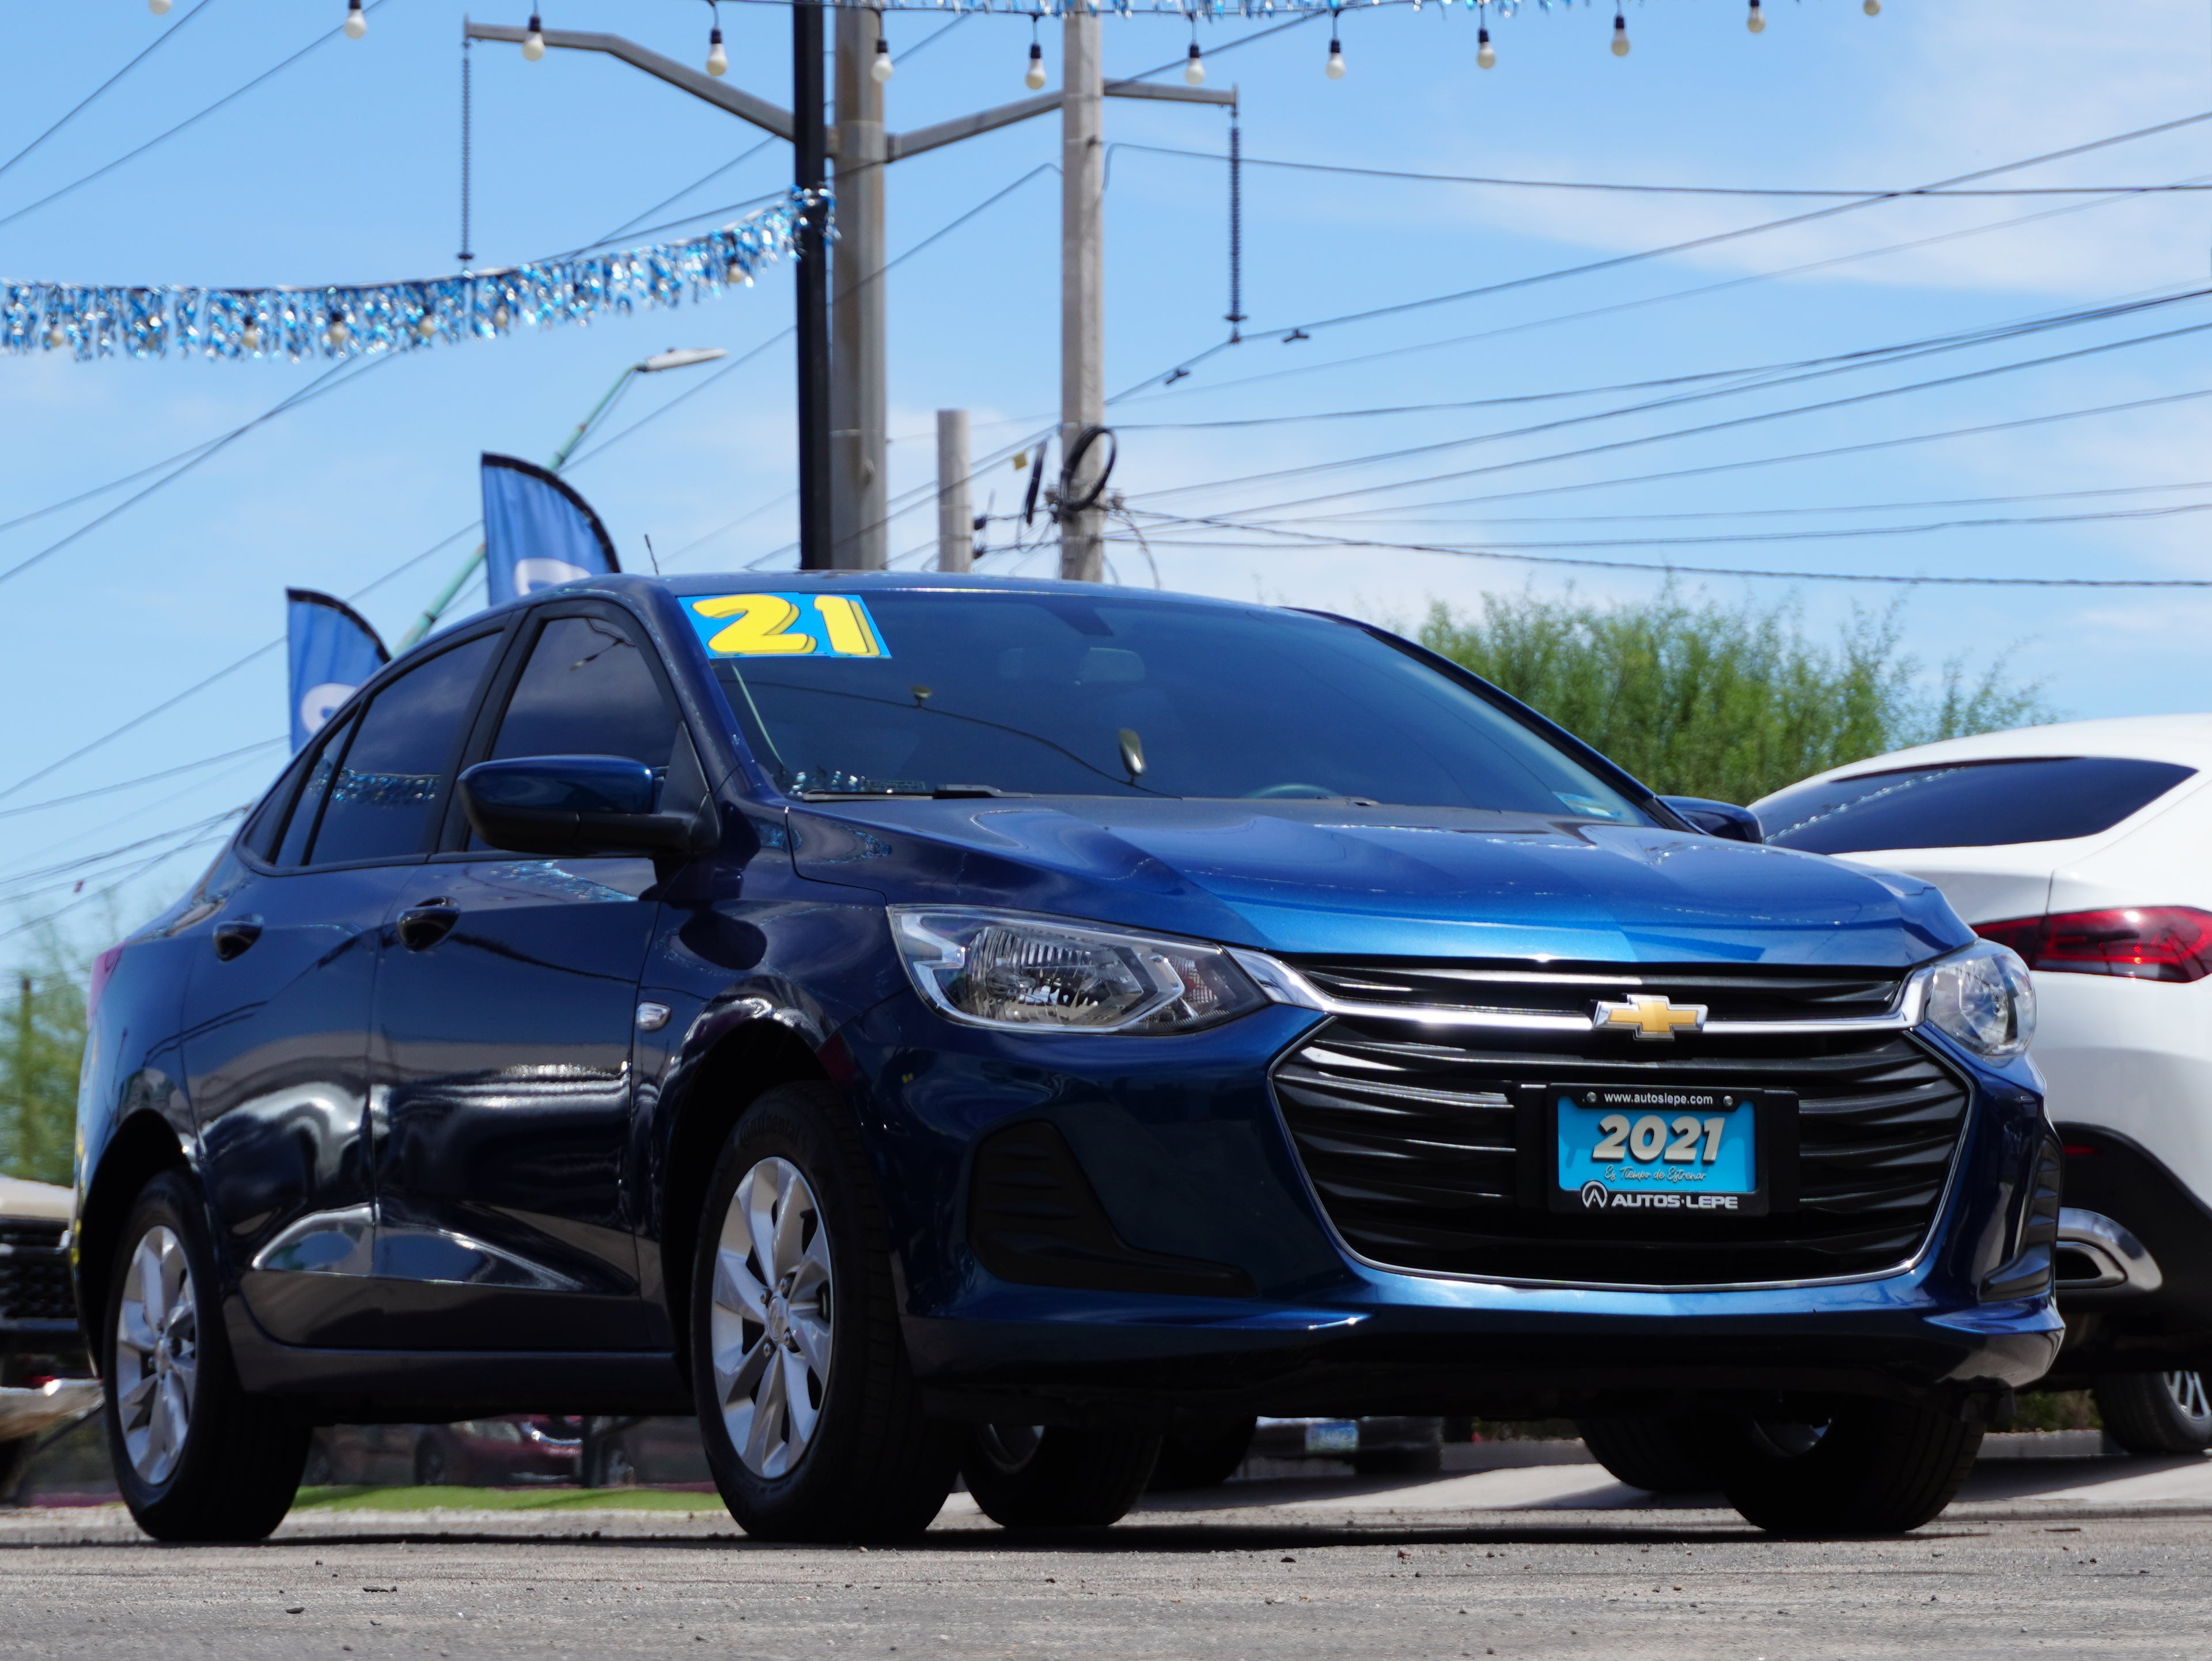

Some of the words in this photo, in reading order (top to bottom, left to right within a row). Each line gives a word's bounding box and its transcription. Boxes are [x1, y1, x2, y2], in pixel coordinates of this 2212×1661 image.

[691, 593, 881, 657] 21
[1604, 1092, 1713, 1106] www.autoslepe.com
[1592, 1114, 1726, 1162] 2021
[1604, 1164, 1617, 1182] Es
[1620, 1166, 1651, 1182] Tiempo
[1653, 1168, 1665, 1180] de
[1667, 1166, 1707, 1183] Estrenar
